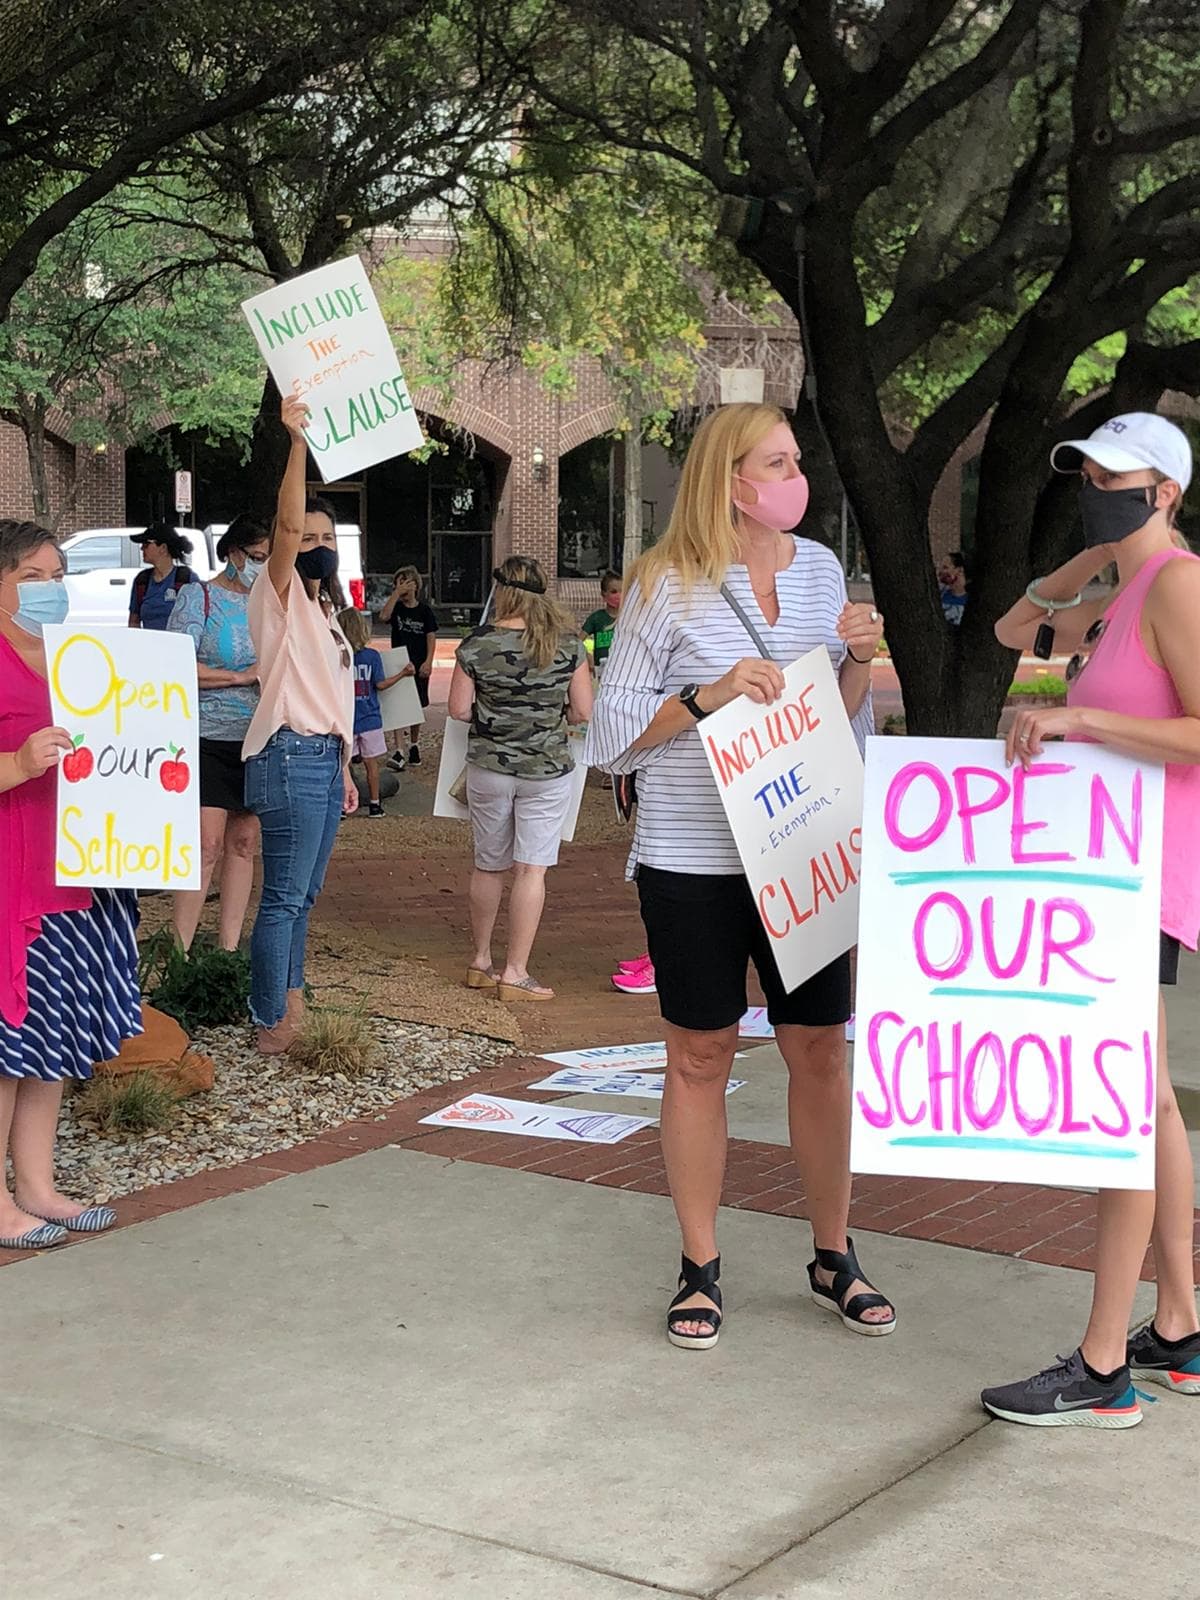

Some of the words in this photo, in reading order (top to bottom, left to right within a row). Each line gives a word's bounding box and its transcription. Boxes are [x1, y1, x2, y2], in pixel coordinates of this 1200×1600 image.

[253, 282, 369, 350] INCLUDE
[306, 334, 342, 361] THE
[291, 348, 376, 397] Exemption
[301, 375, 413, 452] CLAUSE
[52, 633, 192, 735] Open
[96, 744, 167, 779] our
[707, 683, 822, 788] INCLUDE
[753, 761, 812, 820] THE
[769, 795, 832, 850] Exemption
[883, 760, 1144, 866] OPEN
[56, 804, 193, 882] Schools
[758, 827, 862, 940] CLAUS
[912, 891, 1117, 987] OUR
[856, 1010, 1155, 1138] SCHOOLS!
